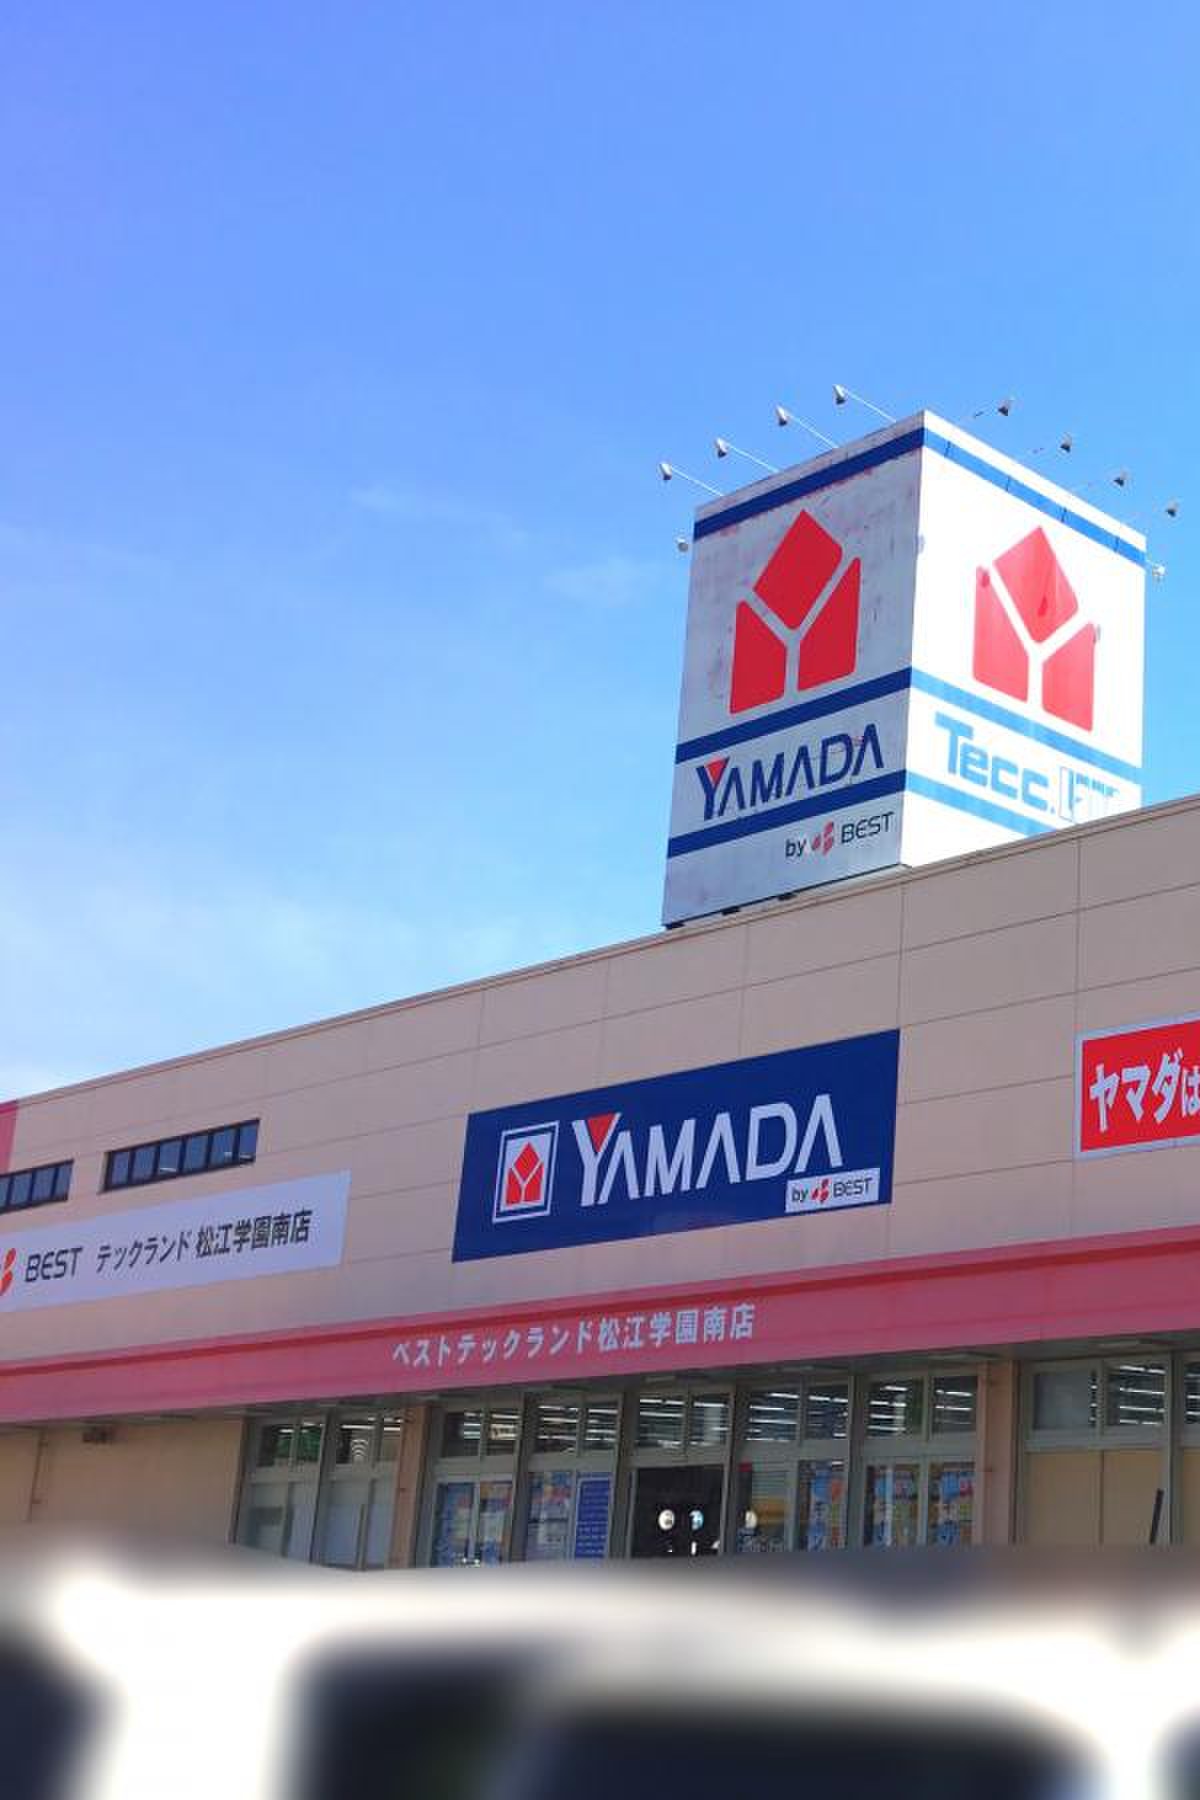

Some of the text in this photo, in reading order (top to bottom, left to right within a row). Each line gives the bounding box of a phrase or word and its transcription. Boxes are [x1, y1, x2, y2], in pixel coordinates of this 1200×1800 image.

[696, 723, 884, 820] YAMADA
[785, 811, 894, 858] by BEST
[572, 1093, 843, 1206] YAMADA
[792, 1177, 873, 1203] by BEST
[25, 1247, 82, 1282] BEST
